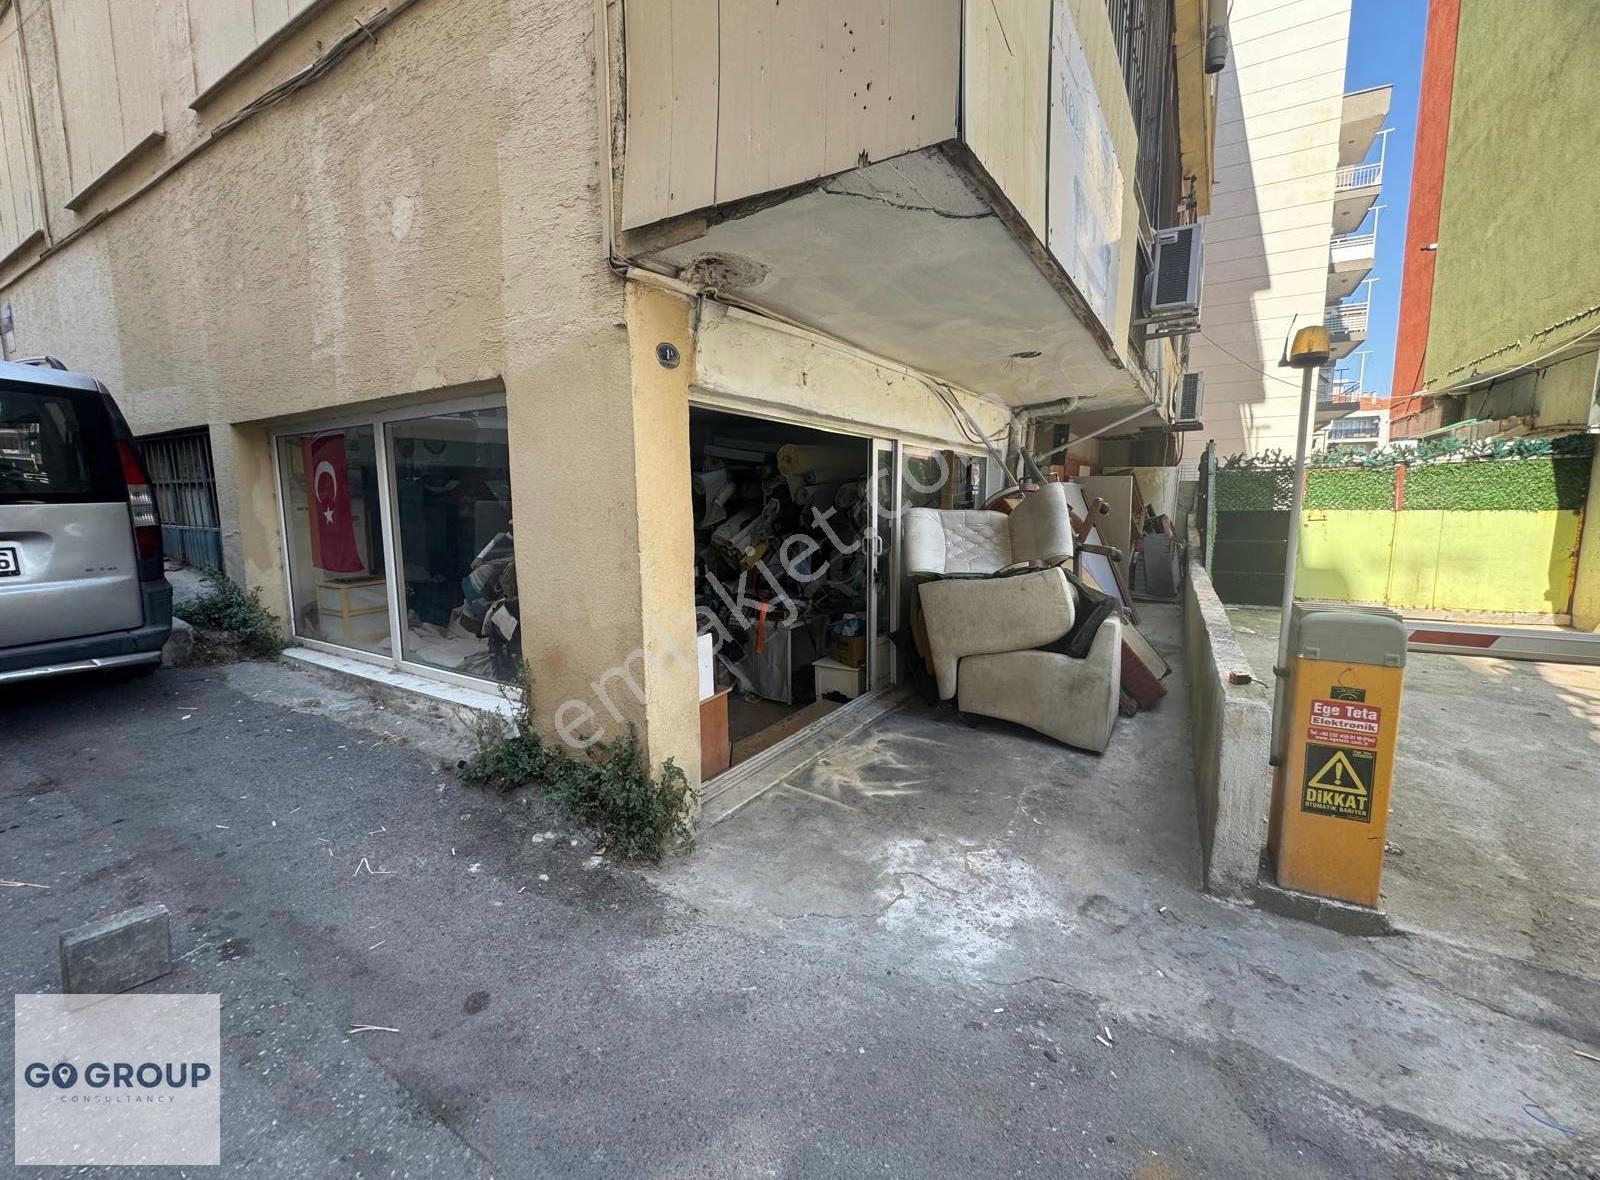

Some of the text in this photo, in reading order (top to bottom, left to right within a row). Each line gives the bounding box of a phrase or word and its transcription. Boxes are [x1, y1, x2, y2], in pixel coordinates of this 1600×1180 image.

[1313, 702, 1378, 720] Ege Teta
[1312, 717, 1376, 732] Elektronik
